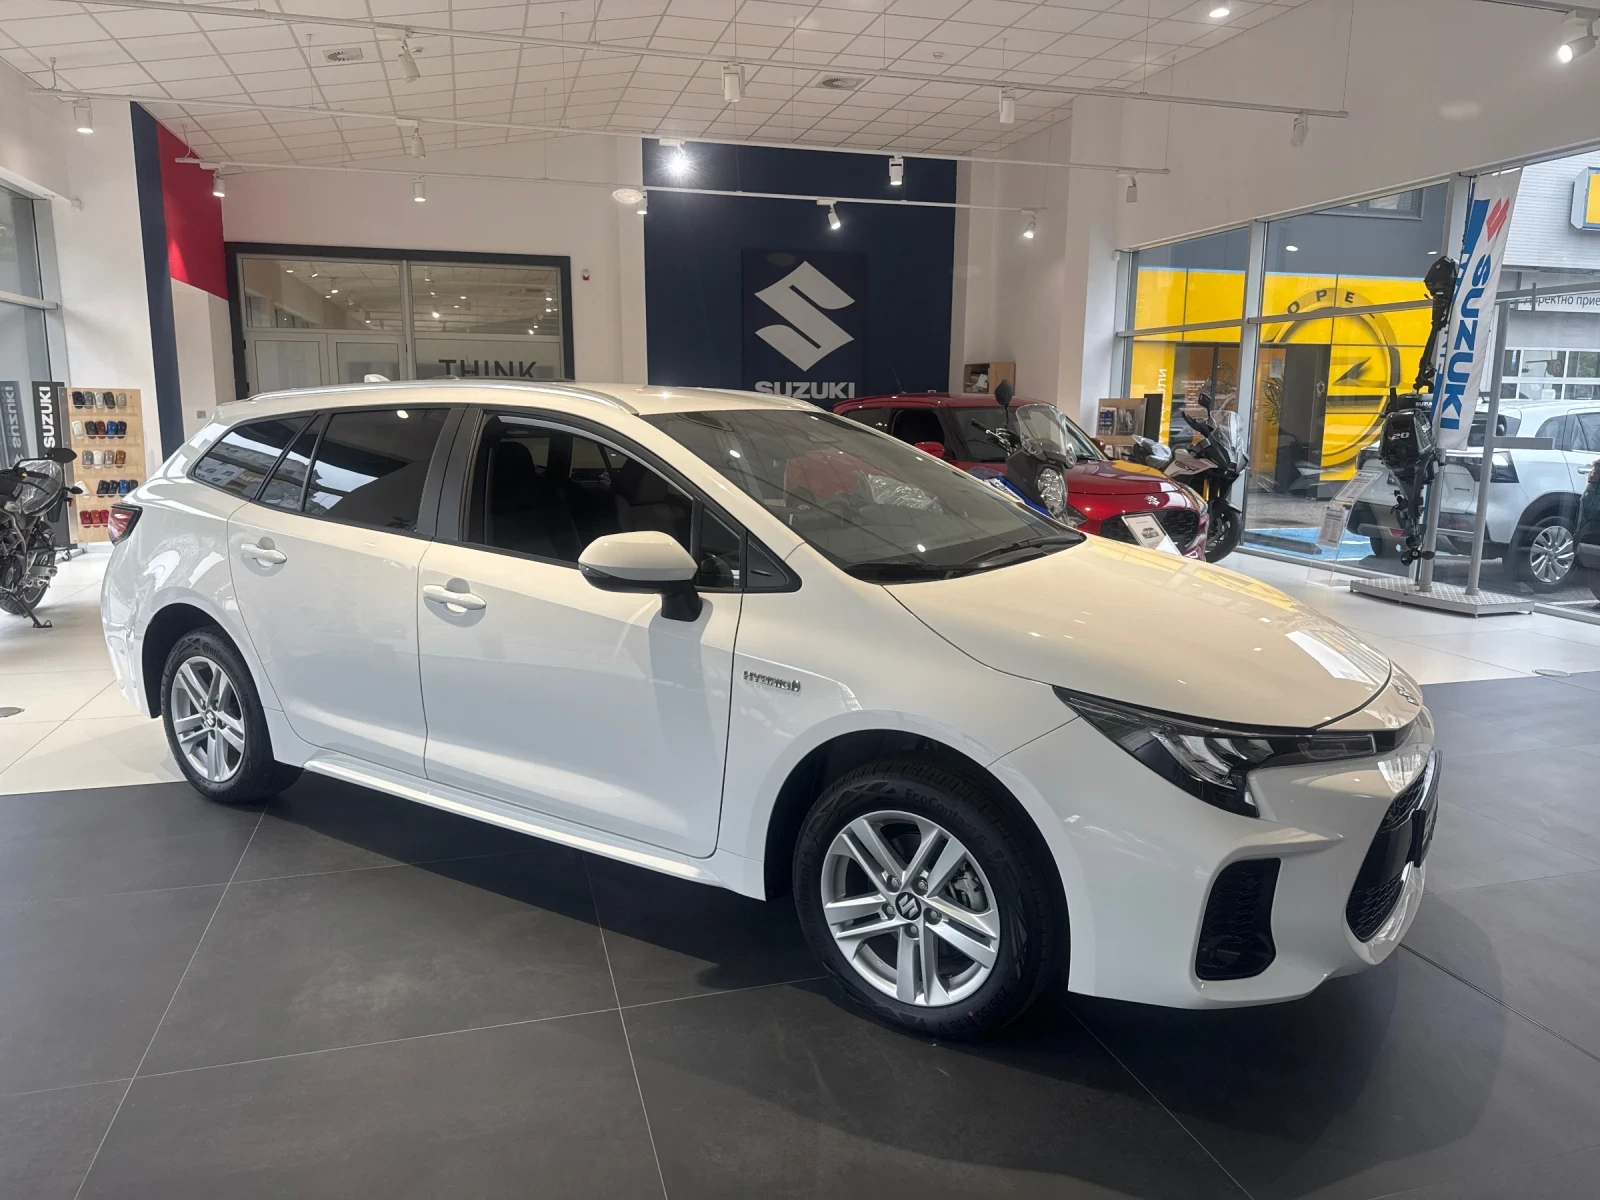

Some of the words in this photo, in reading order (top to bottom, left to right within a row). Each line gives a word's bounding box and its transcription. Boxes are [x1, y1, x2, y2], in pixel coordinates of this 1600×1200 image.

[1287, 289, 1375, 319] OPE
[1440, 254, 1492, 430] SUZUKI
[438, 359, 538, 378] THINK
[754, 381, 855, 399] SUZUKI
[38, 386, 56, 448] SUZUKI
